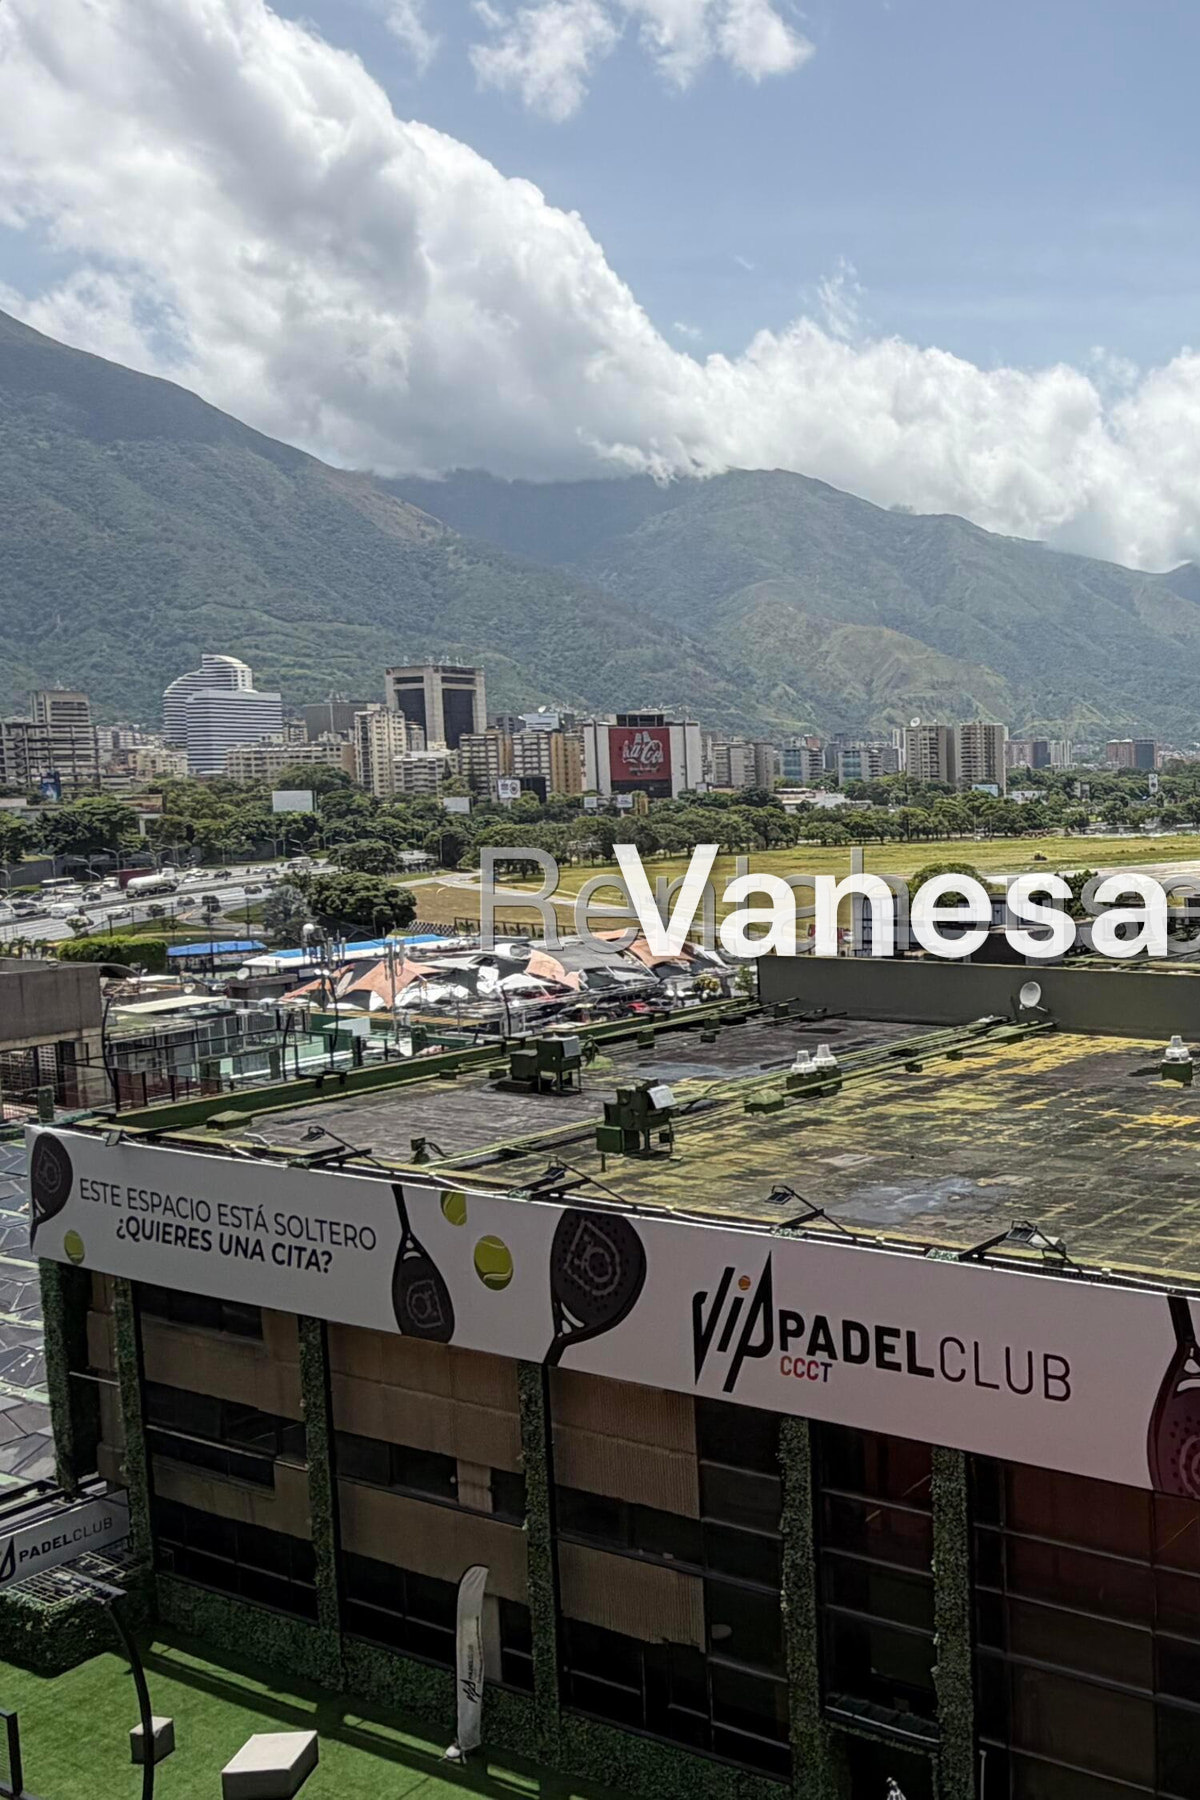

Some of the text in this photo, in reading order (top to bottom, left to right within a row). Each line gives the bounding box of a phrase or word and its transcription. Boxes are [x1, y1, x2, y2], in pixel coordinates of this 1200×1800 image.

[79, 1178, 377, 1251] ESTE ESPACIO ESTÁ SOLTERO
[115, 1216, 333, 1274] ¿QUIERES UNA CITA?
[780, 1355, 833, 1383] CCCT
